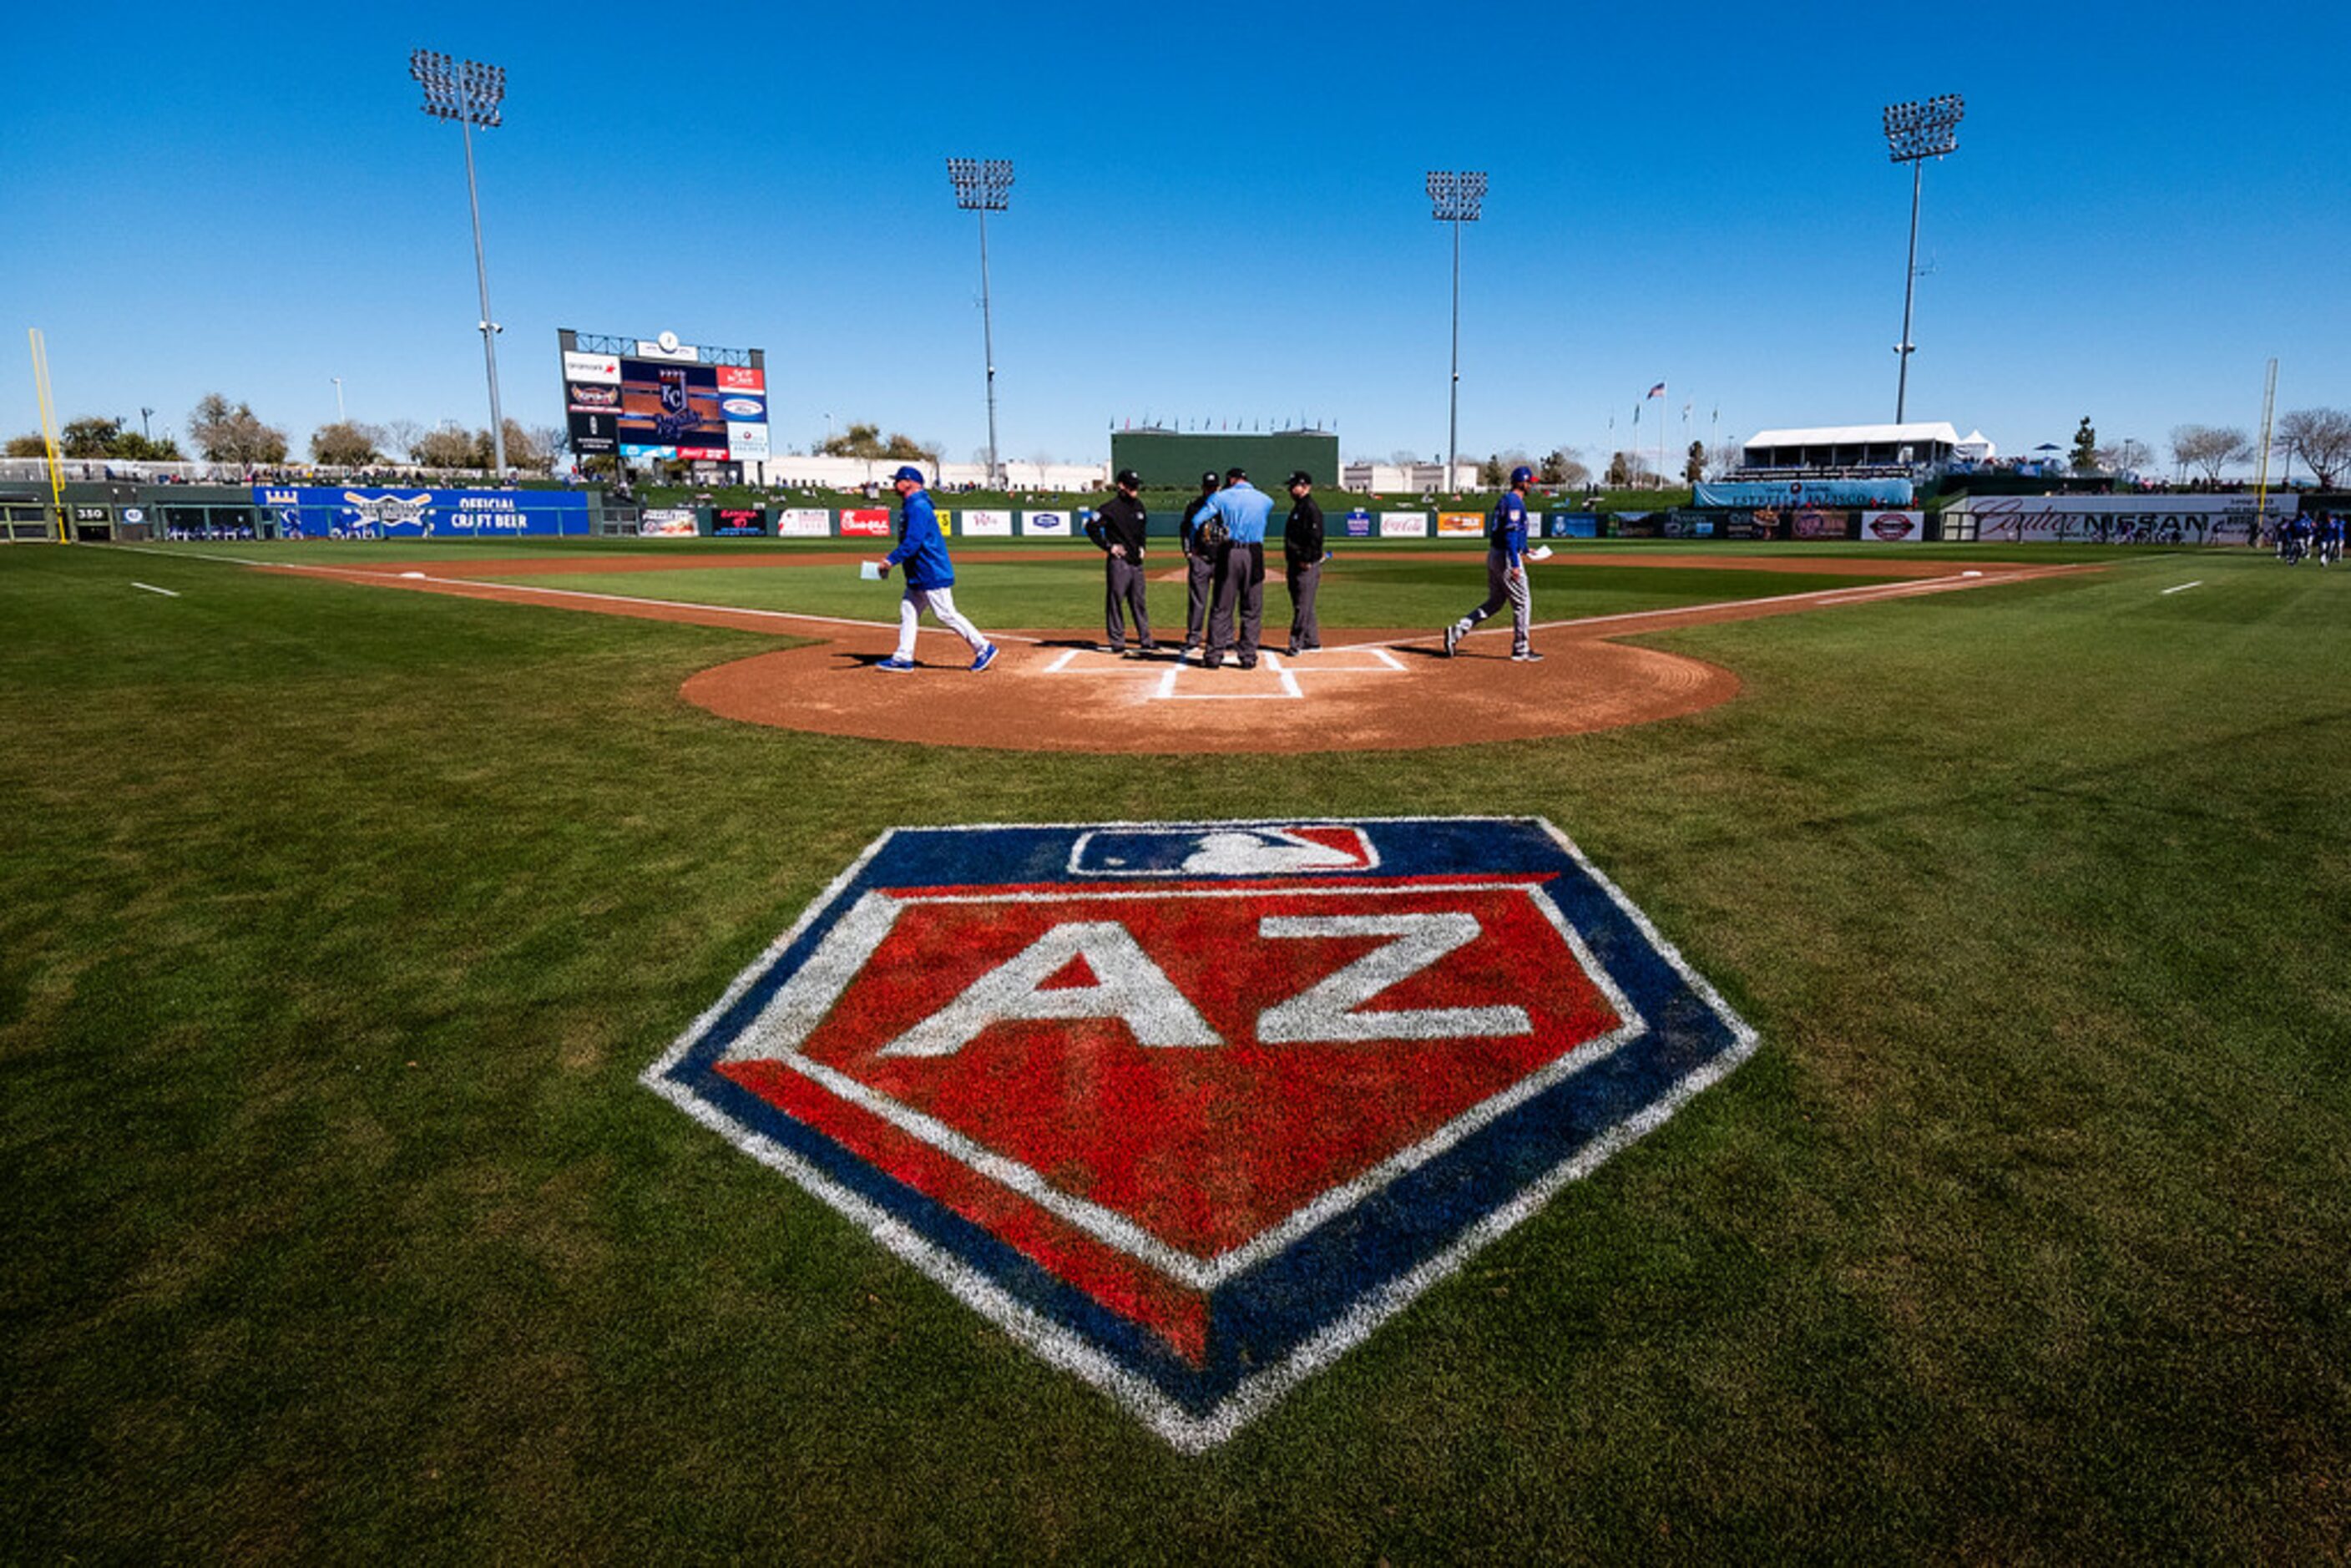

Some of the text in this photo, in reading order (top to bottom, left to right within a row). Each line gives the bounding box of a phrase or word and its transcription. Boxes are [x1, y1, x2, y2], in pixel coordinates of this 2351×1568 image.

[662, 384, 681, 407] KC
[77, 508, 104, 519] 350
[459, 498, 515, 513] OFFICIAL
[451, 513, 528, 528] CRAFT BEER
[2084, 513, 2209, 534] NISSAN
[877, 911, 1534, 1059] AZ
